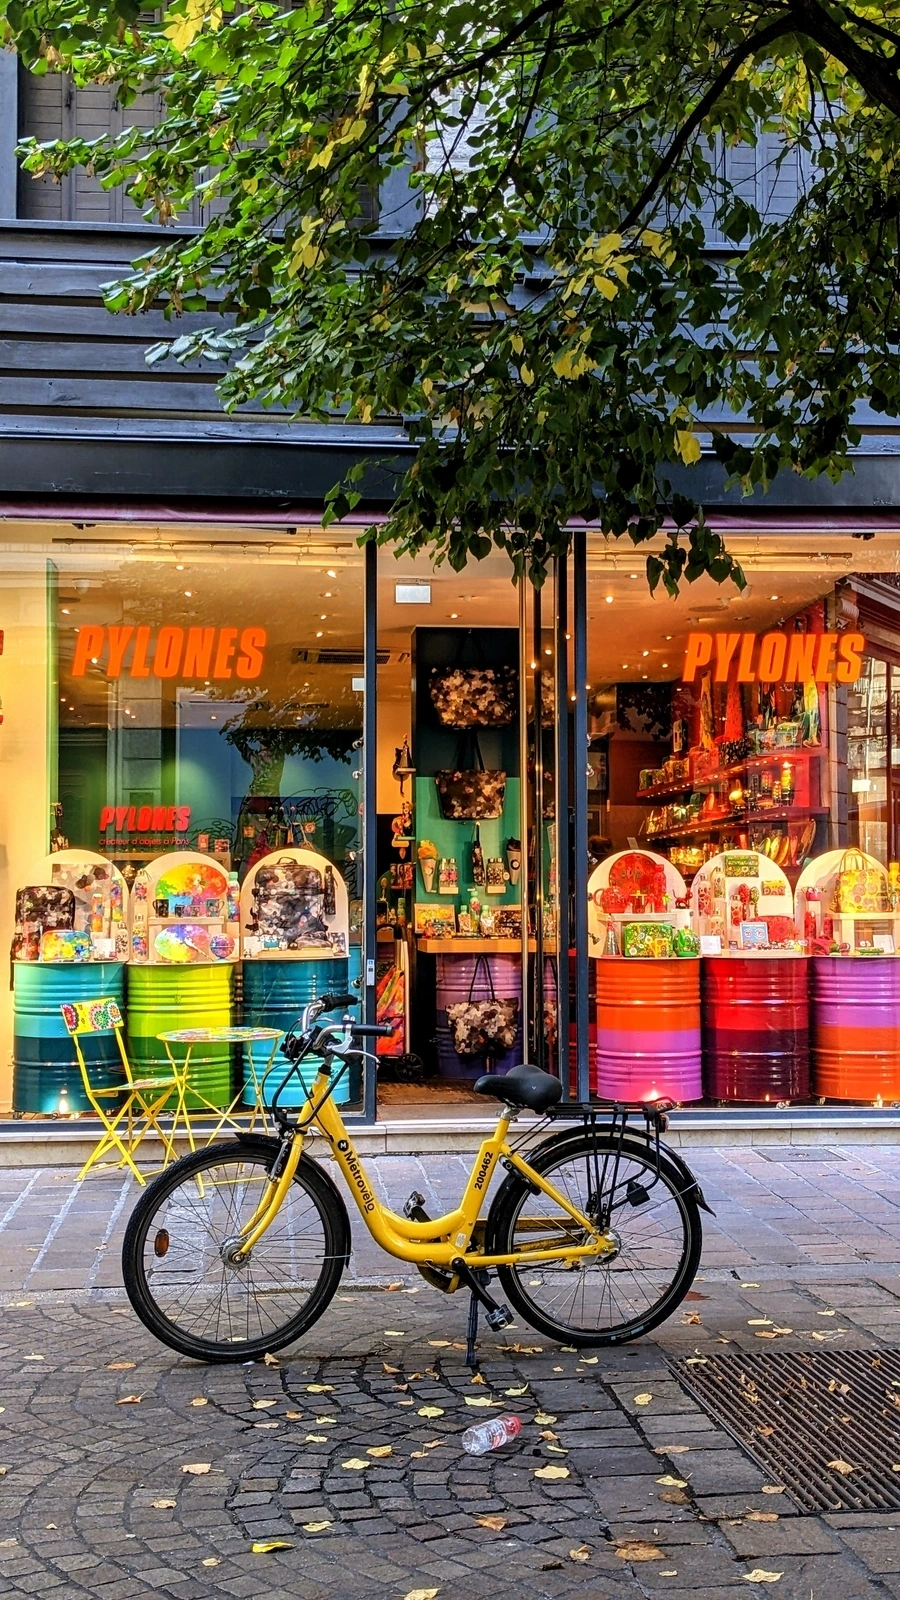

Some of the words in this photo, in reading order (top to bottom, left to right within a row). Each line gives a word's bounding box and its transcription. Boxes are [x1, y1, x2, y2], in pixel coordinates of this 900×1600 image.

[72, 626, 267, 679] PYLONES
[682, 633, 866, 683] PYLONES
[99, 806, 191, 832] PYLONES
[99, 837, 130, 845] créateur
[171, 837, 190, 845] Paris
[474, 1151, 494, 1190] 200462
